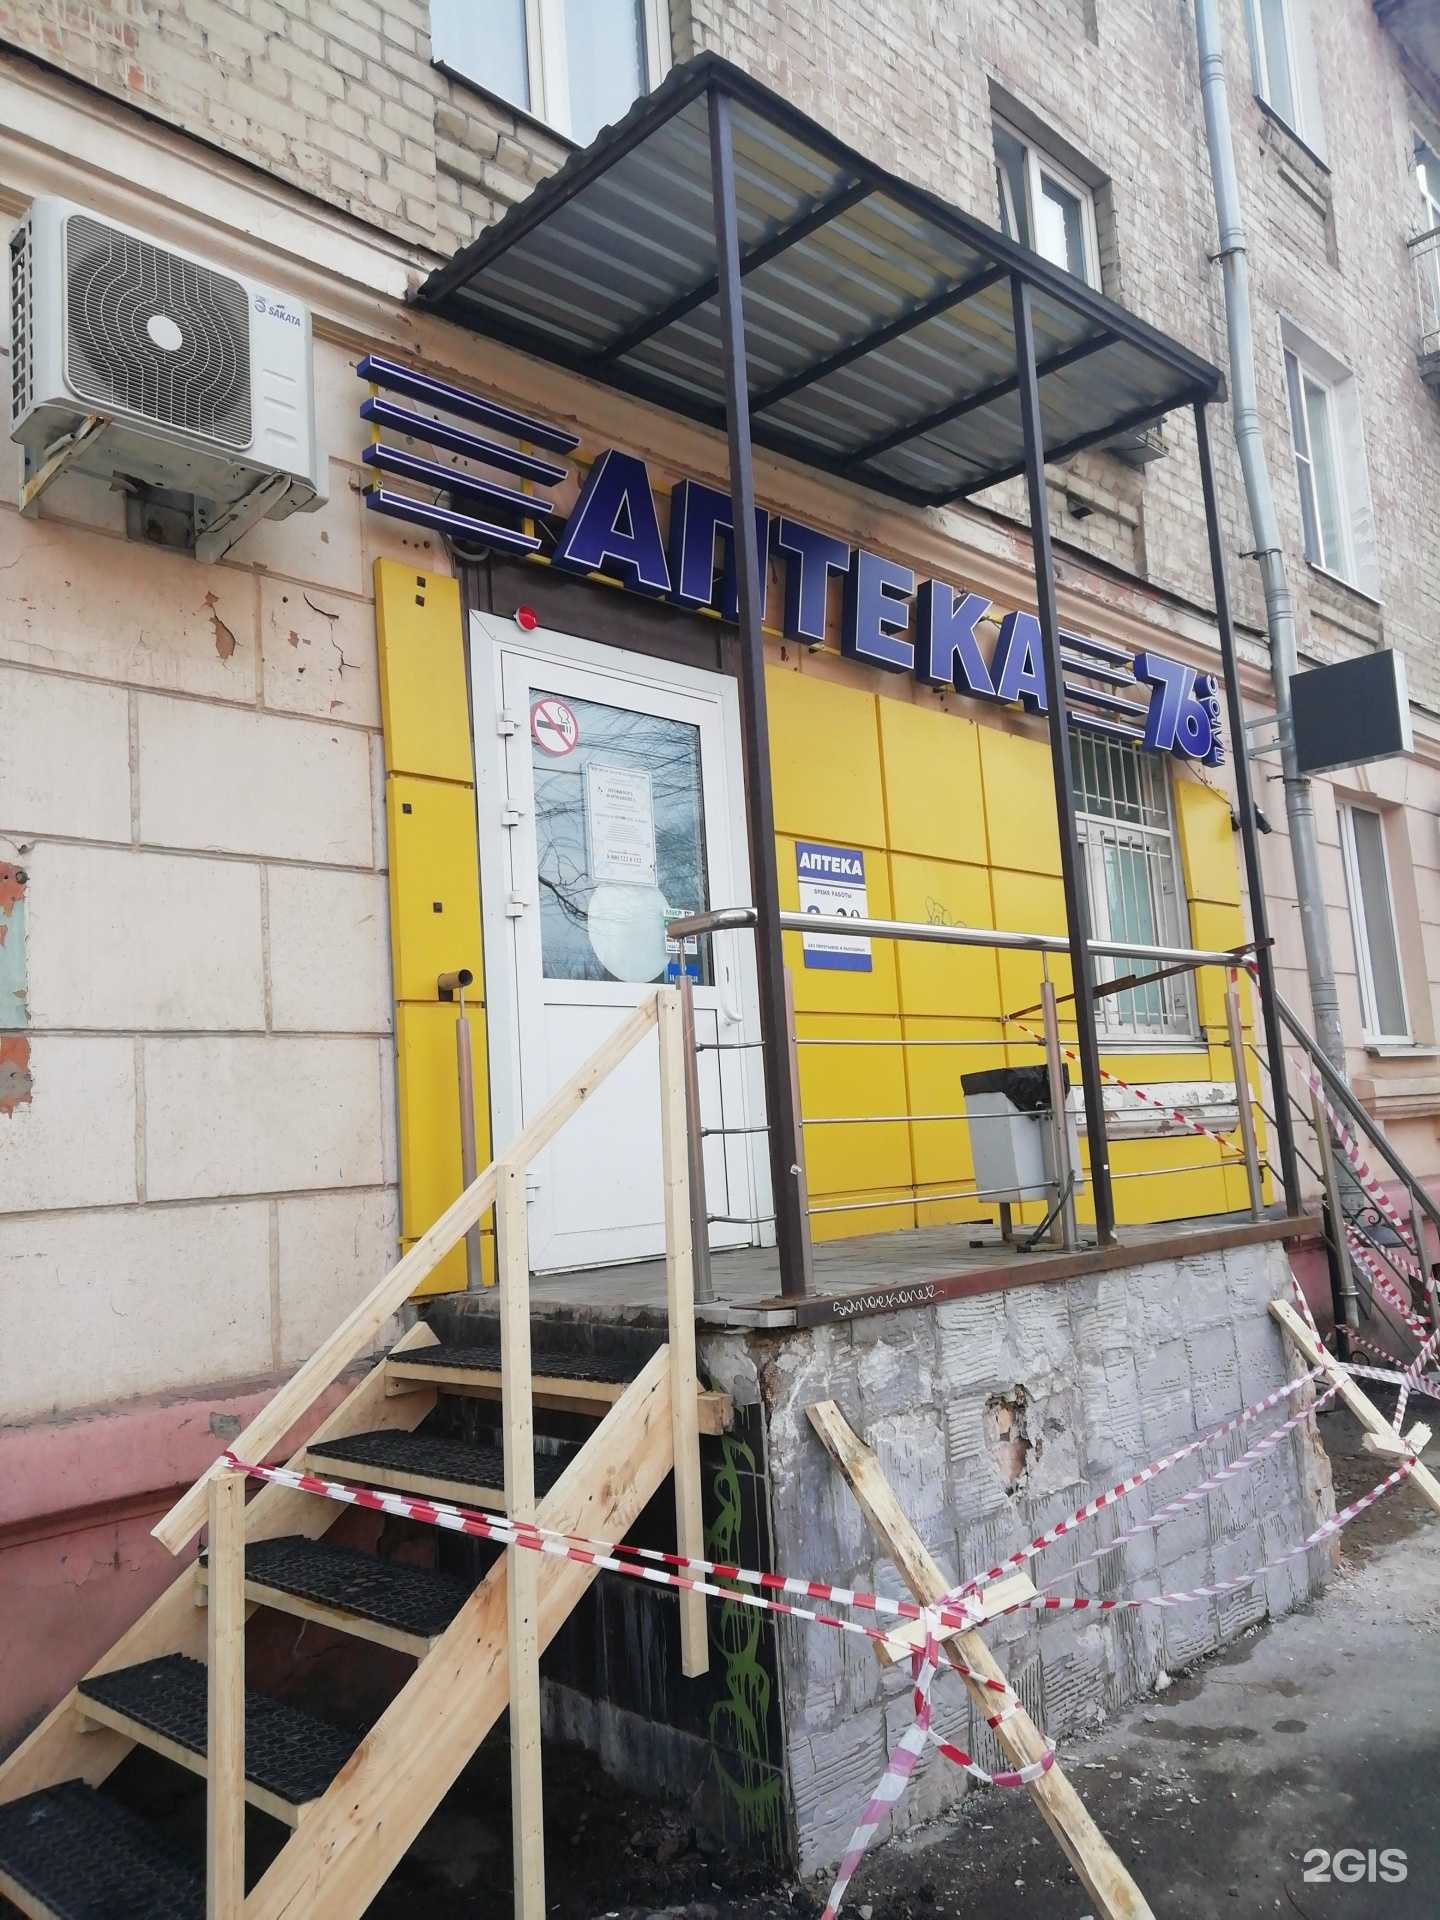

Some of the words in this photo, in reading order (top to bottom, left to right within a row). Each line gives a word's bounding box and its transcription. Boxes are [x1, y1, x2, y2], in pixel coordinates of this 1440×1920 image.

[268, 306, 301, 327] SAKATA
[556, 447, 1049, 713] АПТЕКА
[1137, 651, 1212, 759] 76
[799, 851, 863, 876] АПТЕКА
